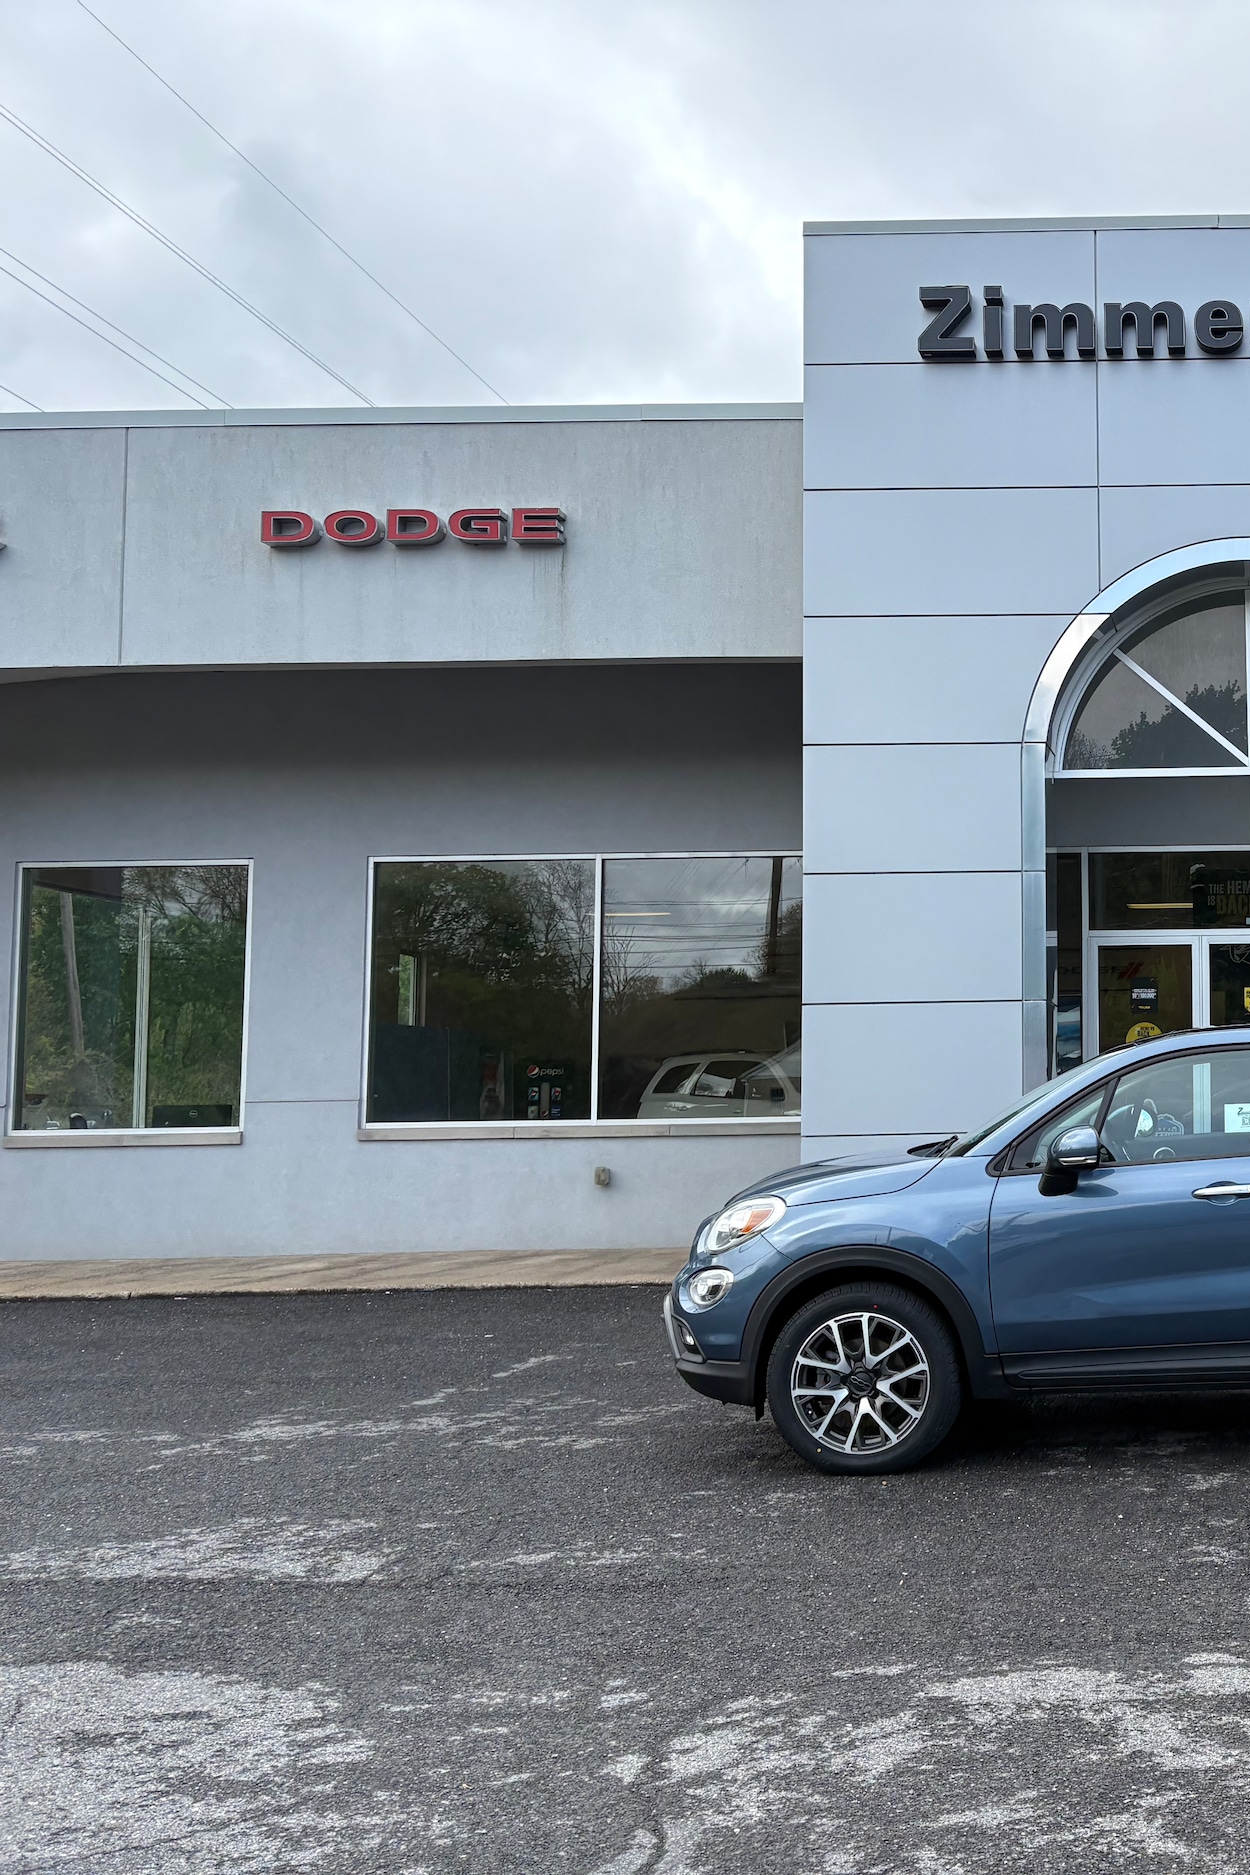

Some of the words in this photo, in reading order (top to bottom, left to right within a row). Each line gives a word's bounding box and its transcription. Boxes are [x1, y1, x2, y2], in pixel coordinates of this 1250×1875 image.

[261, 508, 566, 547] DODGE
[1208, 883, 1225, 894] THE
[1207, 895, 1216, 906] IS
[540, 1067, 564, 1076] pepsi
